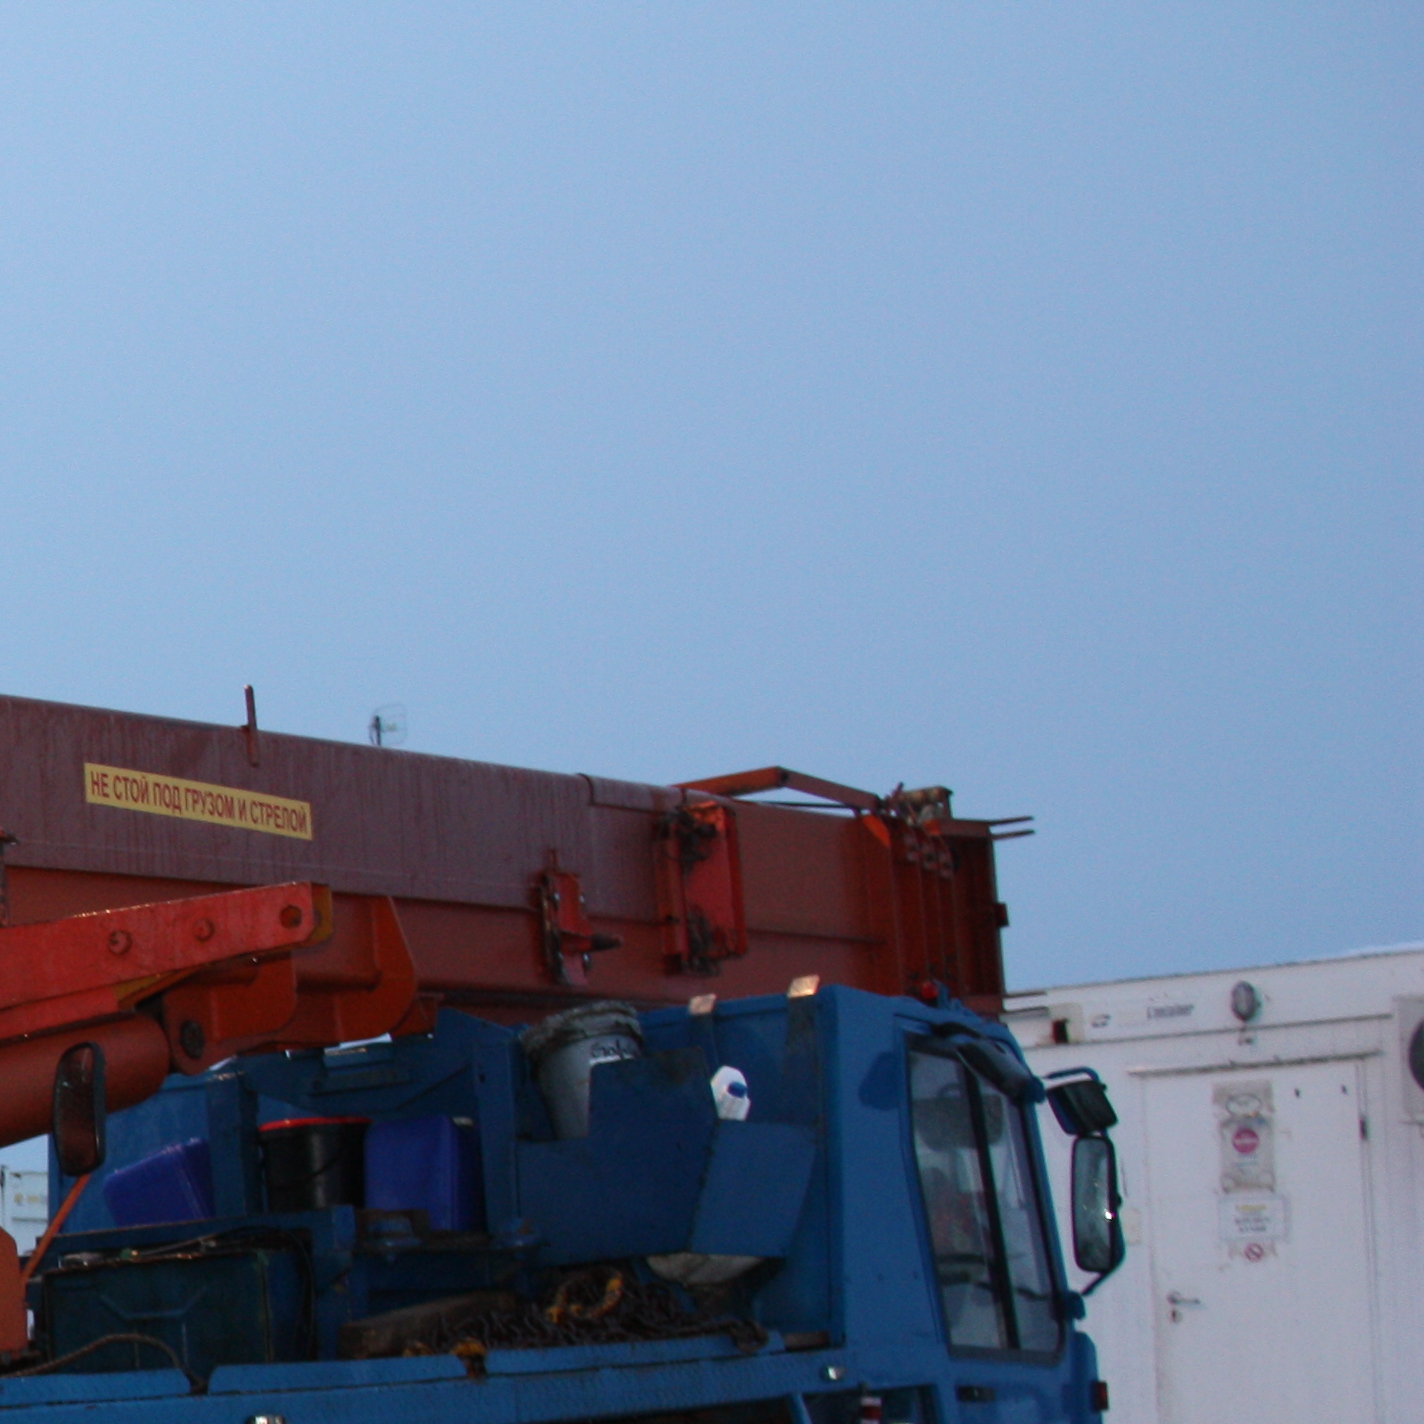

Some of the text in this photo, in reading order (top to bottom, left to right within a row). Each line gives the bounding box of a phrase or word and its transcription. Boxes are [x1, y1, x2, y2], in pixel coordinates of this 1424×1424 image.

[90, 770, 109, 798] НЕ
[113, 776, 149, 804] СТОЙ
[153, 783, 182, 814] ПОД
[185, 788, 235, 820] ГРУЗОМ
[239, 798, 247, 821] И
